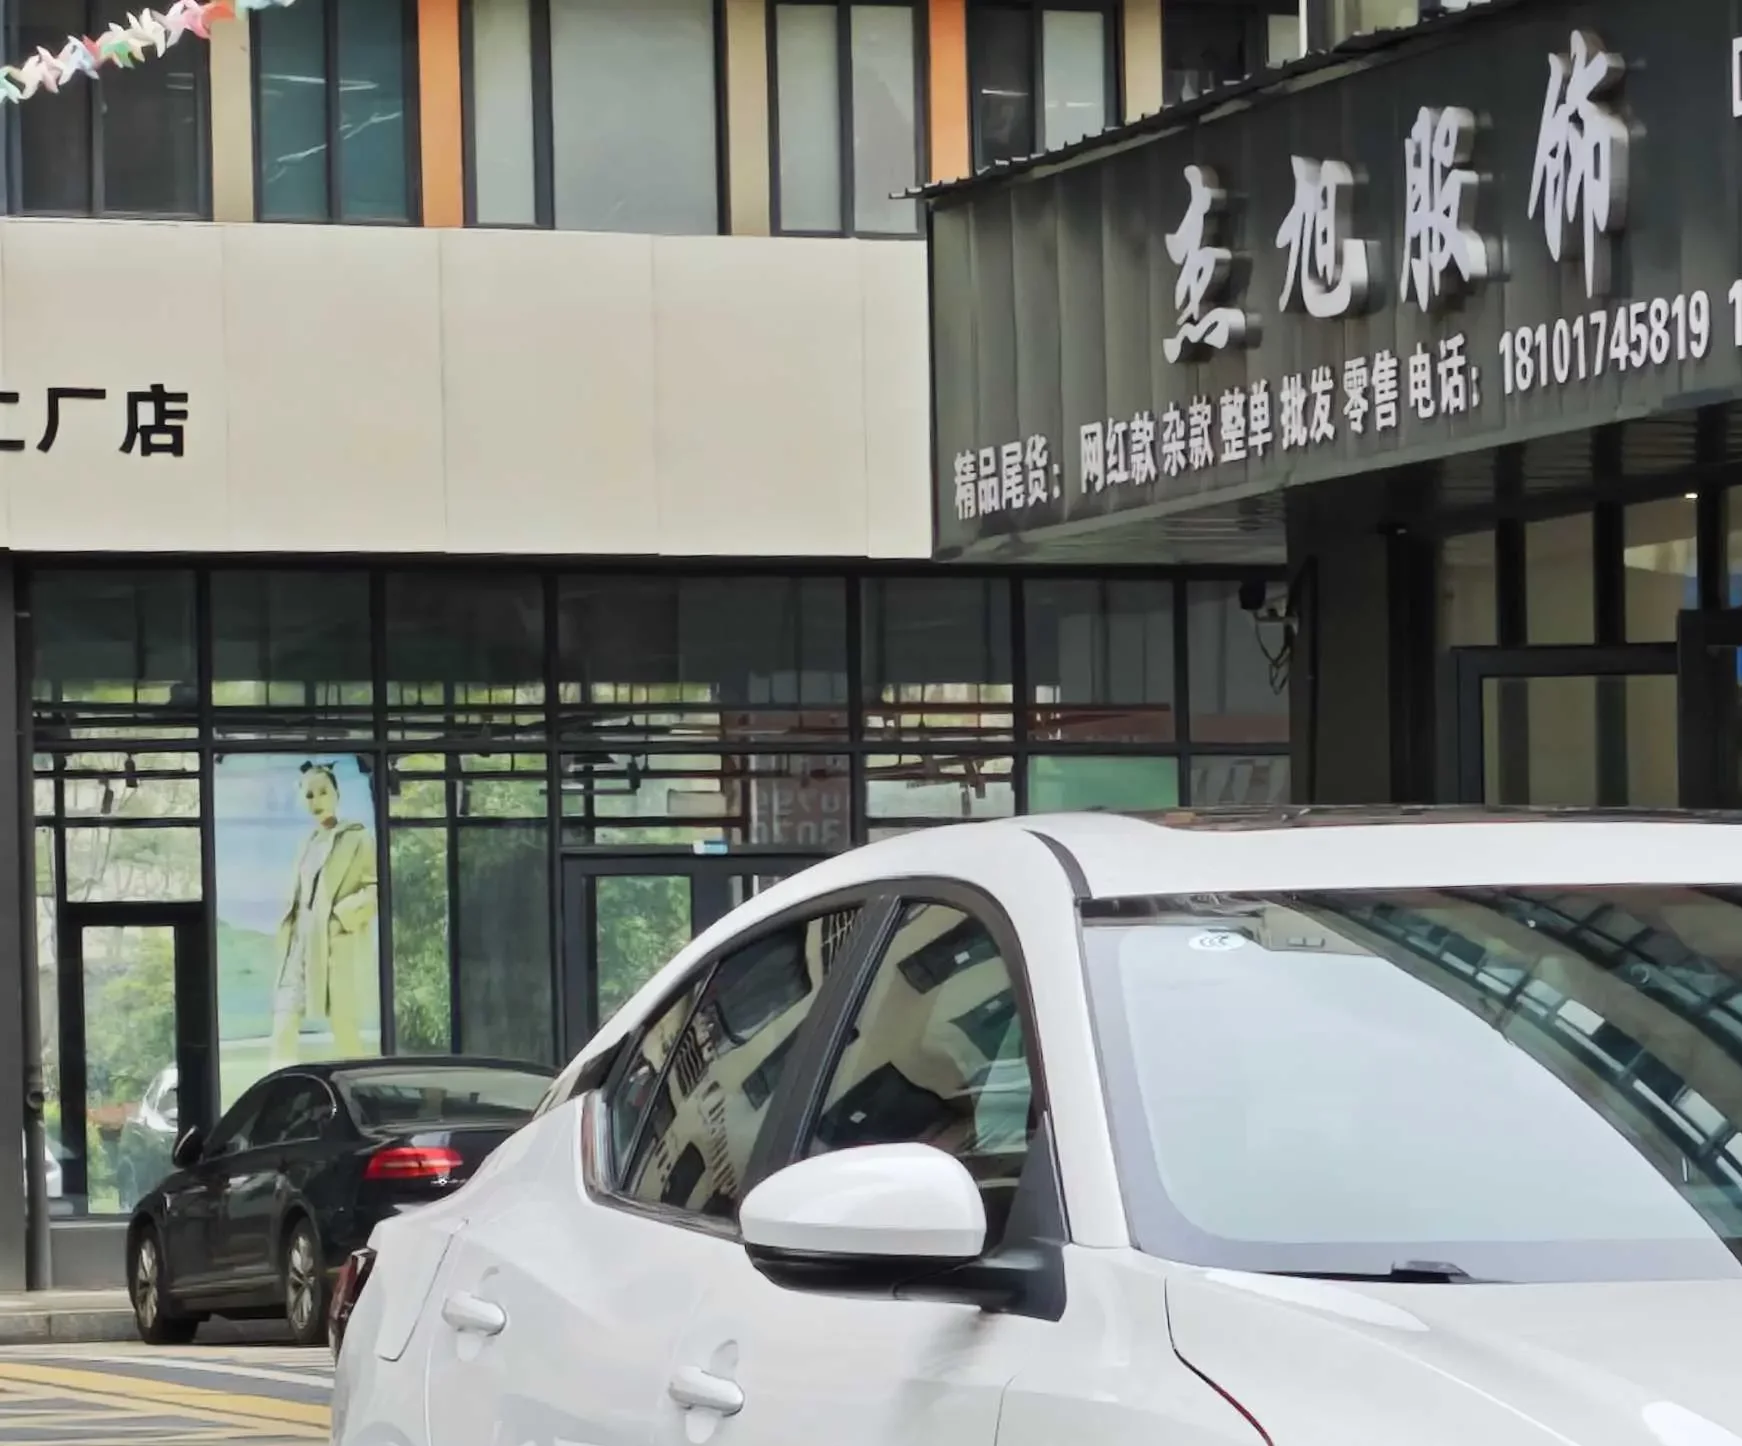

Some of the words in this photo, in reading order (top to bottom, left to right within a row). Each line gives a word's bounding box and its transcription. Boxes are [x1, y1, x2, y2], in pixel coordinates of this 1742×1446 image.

[1163, 28, 1630, 364] 杰旭服饰
[1080, 411, 1157, 493] 网红款
[1162, 395, 1214, 477] 杂款
[1220, 378, 1273, 462] 整单
[1280, 366, 1335, 450] 批发
[1343, 349, 1398, 434] 零售
[1499, 290, 1710, 395] 18101745819
